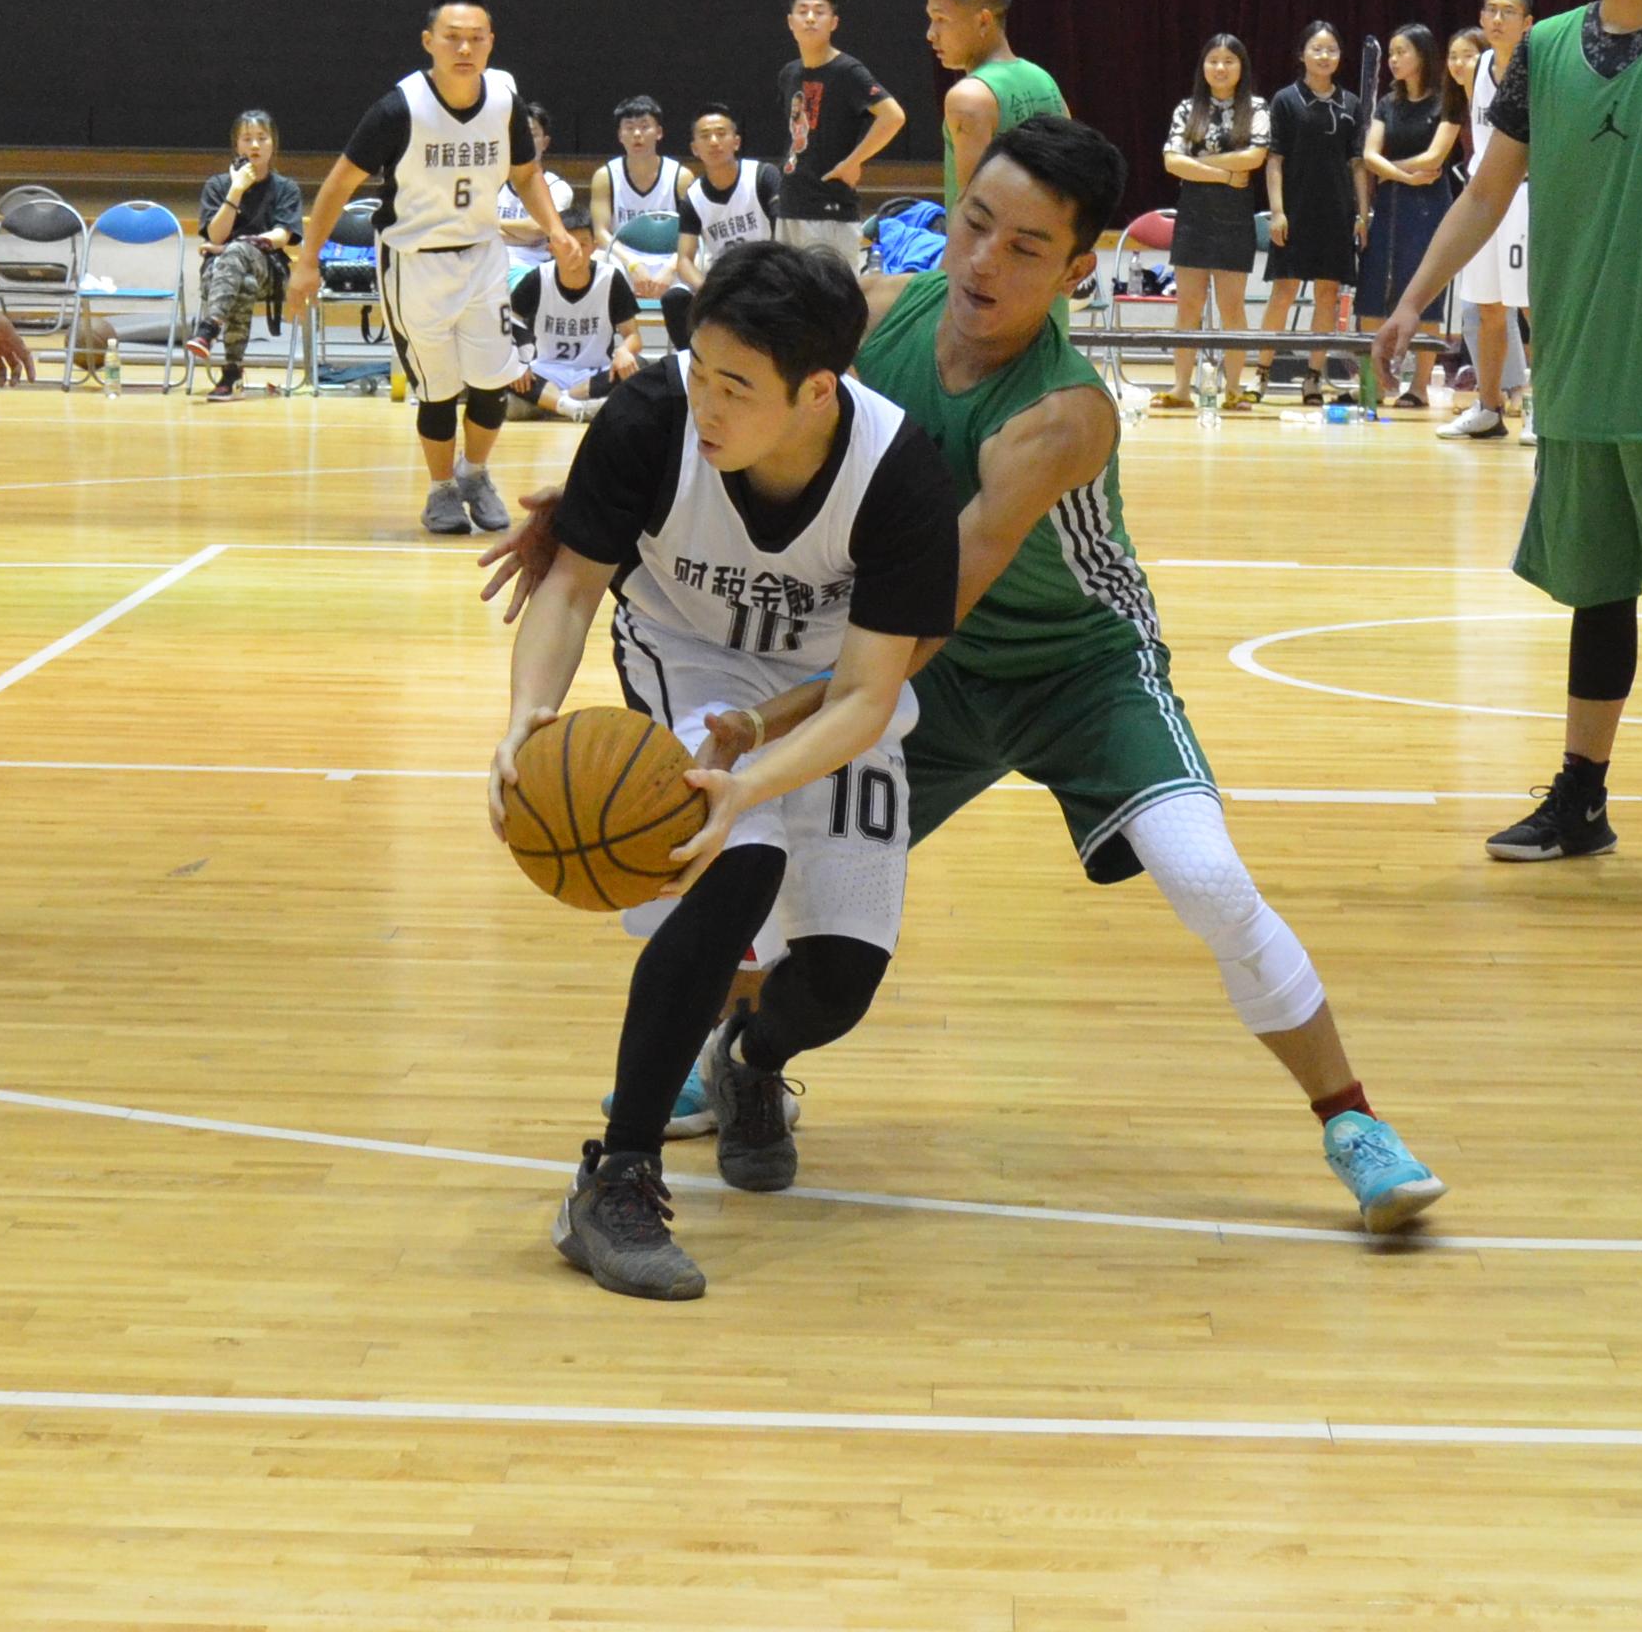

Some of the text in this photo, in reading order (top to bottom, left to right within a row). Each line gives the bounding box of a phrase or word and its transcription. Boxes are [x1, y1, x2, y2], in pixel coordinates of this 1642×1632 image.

[454, 177, 471, 209] 6
[555, 341, 581, 361] 21
[826, 761, 898, 845] 10
